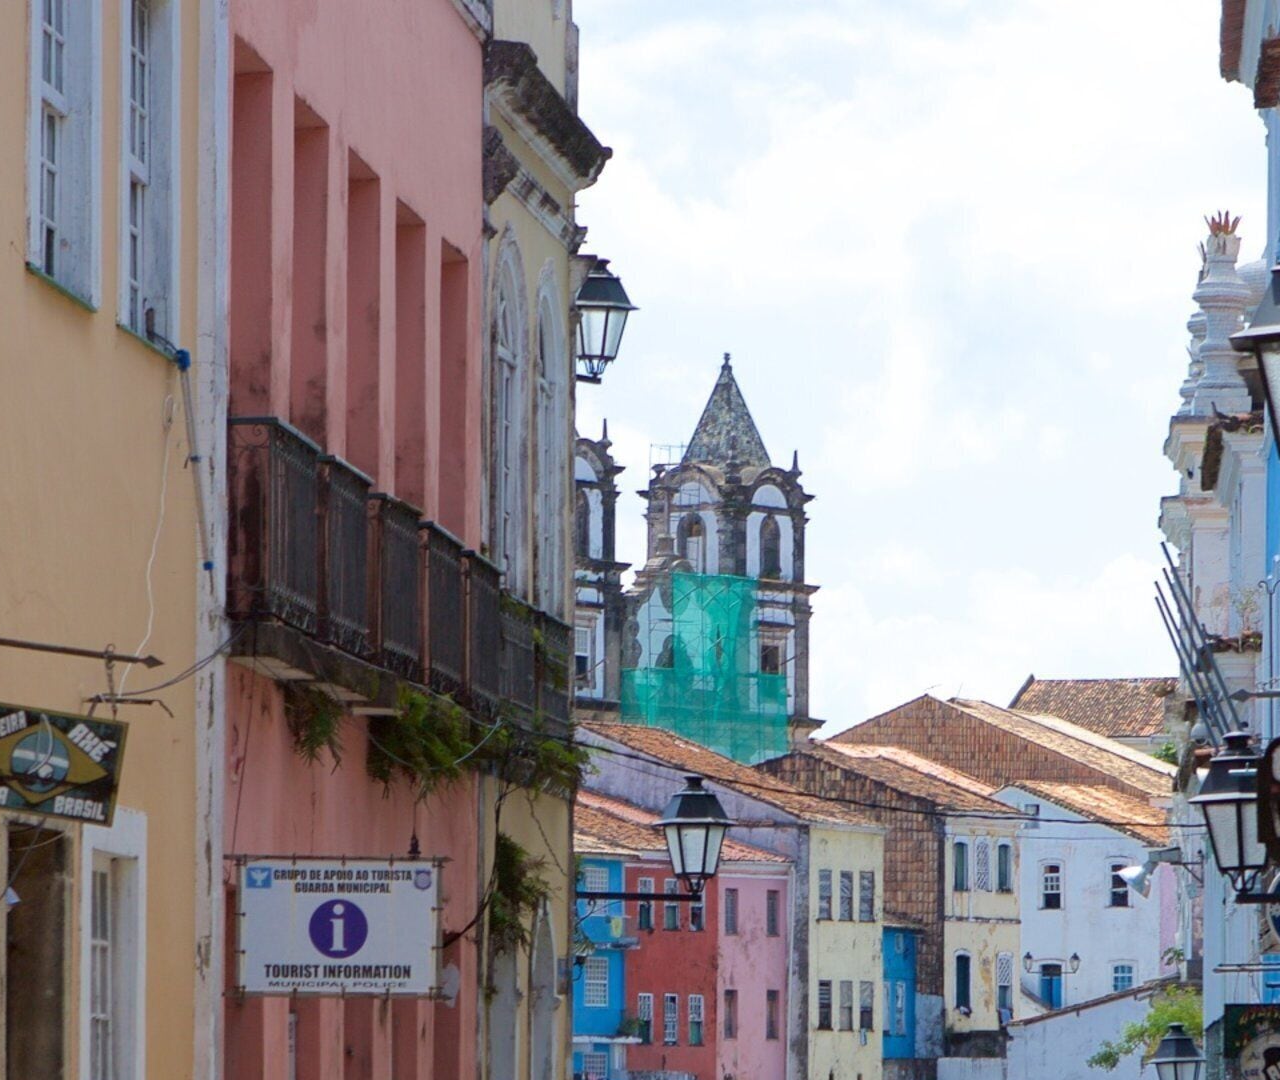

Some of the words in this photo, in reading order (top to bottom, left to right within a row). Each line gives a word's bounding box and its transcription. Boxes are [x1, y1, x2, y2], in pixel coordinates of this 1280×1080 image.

[67, 723, 117, 762] AXÉ
[54, 795, 105, 820] BRASIL
[274, 870, 307, 881] GRUPO
[309, 870, 321, 881] DE
[323, 870, 353, 881] APOIO
[356, 870, 369, 881] AO
[371, 870, 412, 881] TURISTA
[294, 882, 334, 893] GUARDA
[337, 882, 391, 893] MUNICIPAL
[264, 965, 320, 979] TOURIST
[323, 965, 411, 979] INFORMATION
